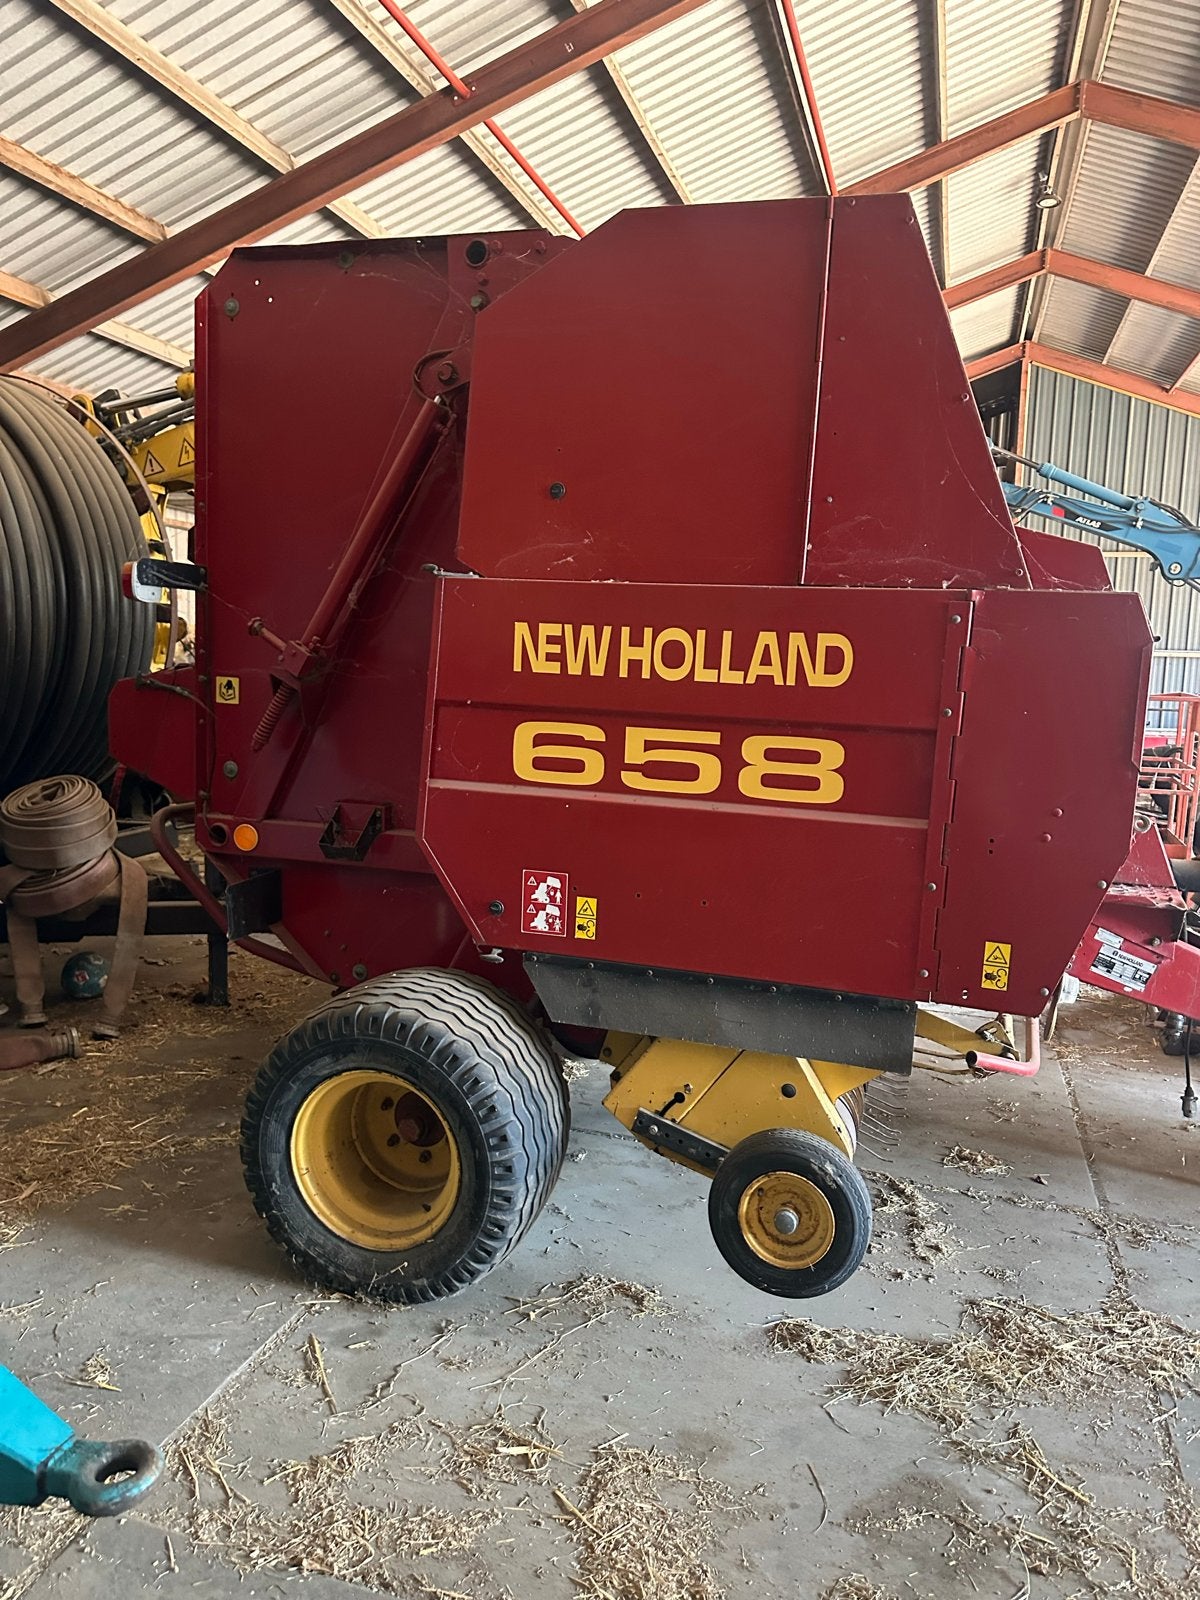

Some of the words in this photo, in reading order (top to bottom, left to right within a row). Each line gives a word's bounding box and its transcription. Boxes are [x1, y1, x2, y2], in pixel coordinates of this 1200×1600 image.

[1075, 516, 1102, 529] ATLAS
[513, 621, 612, 676] NEW
[619, 627, 854, 687] HOLLAND
[513, 721, 845, 804] 658
[1126, 957, 1144, 967] HOLLAND
